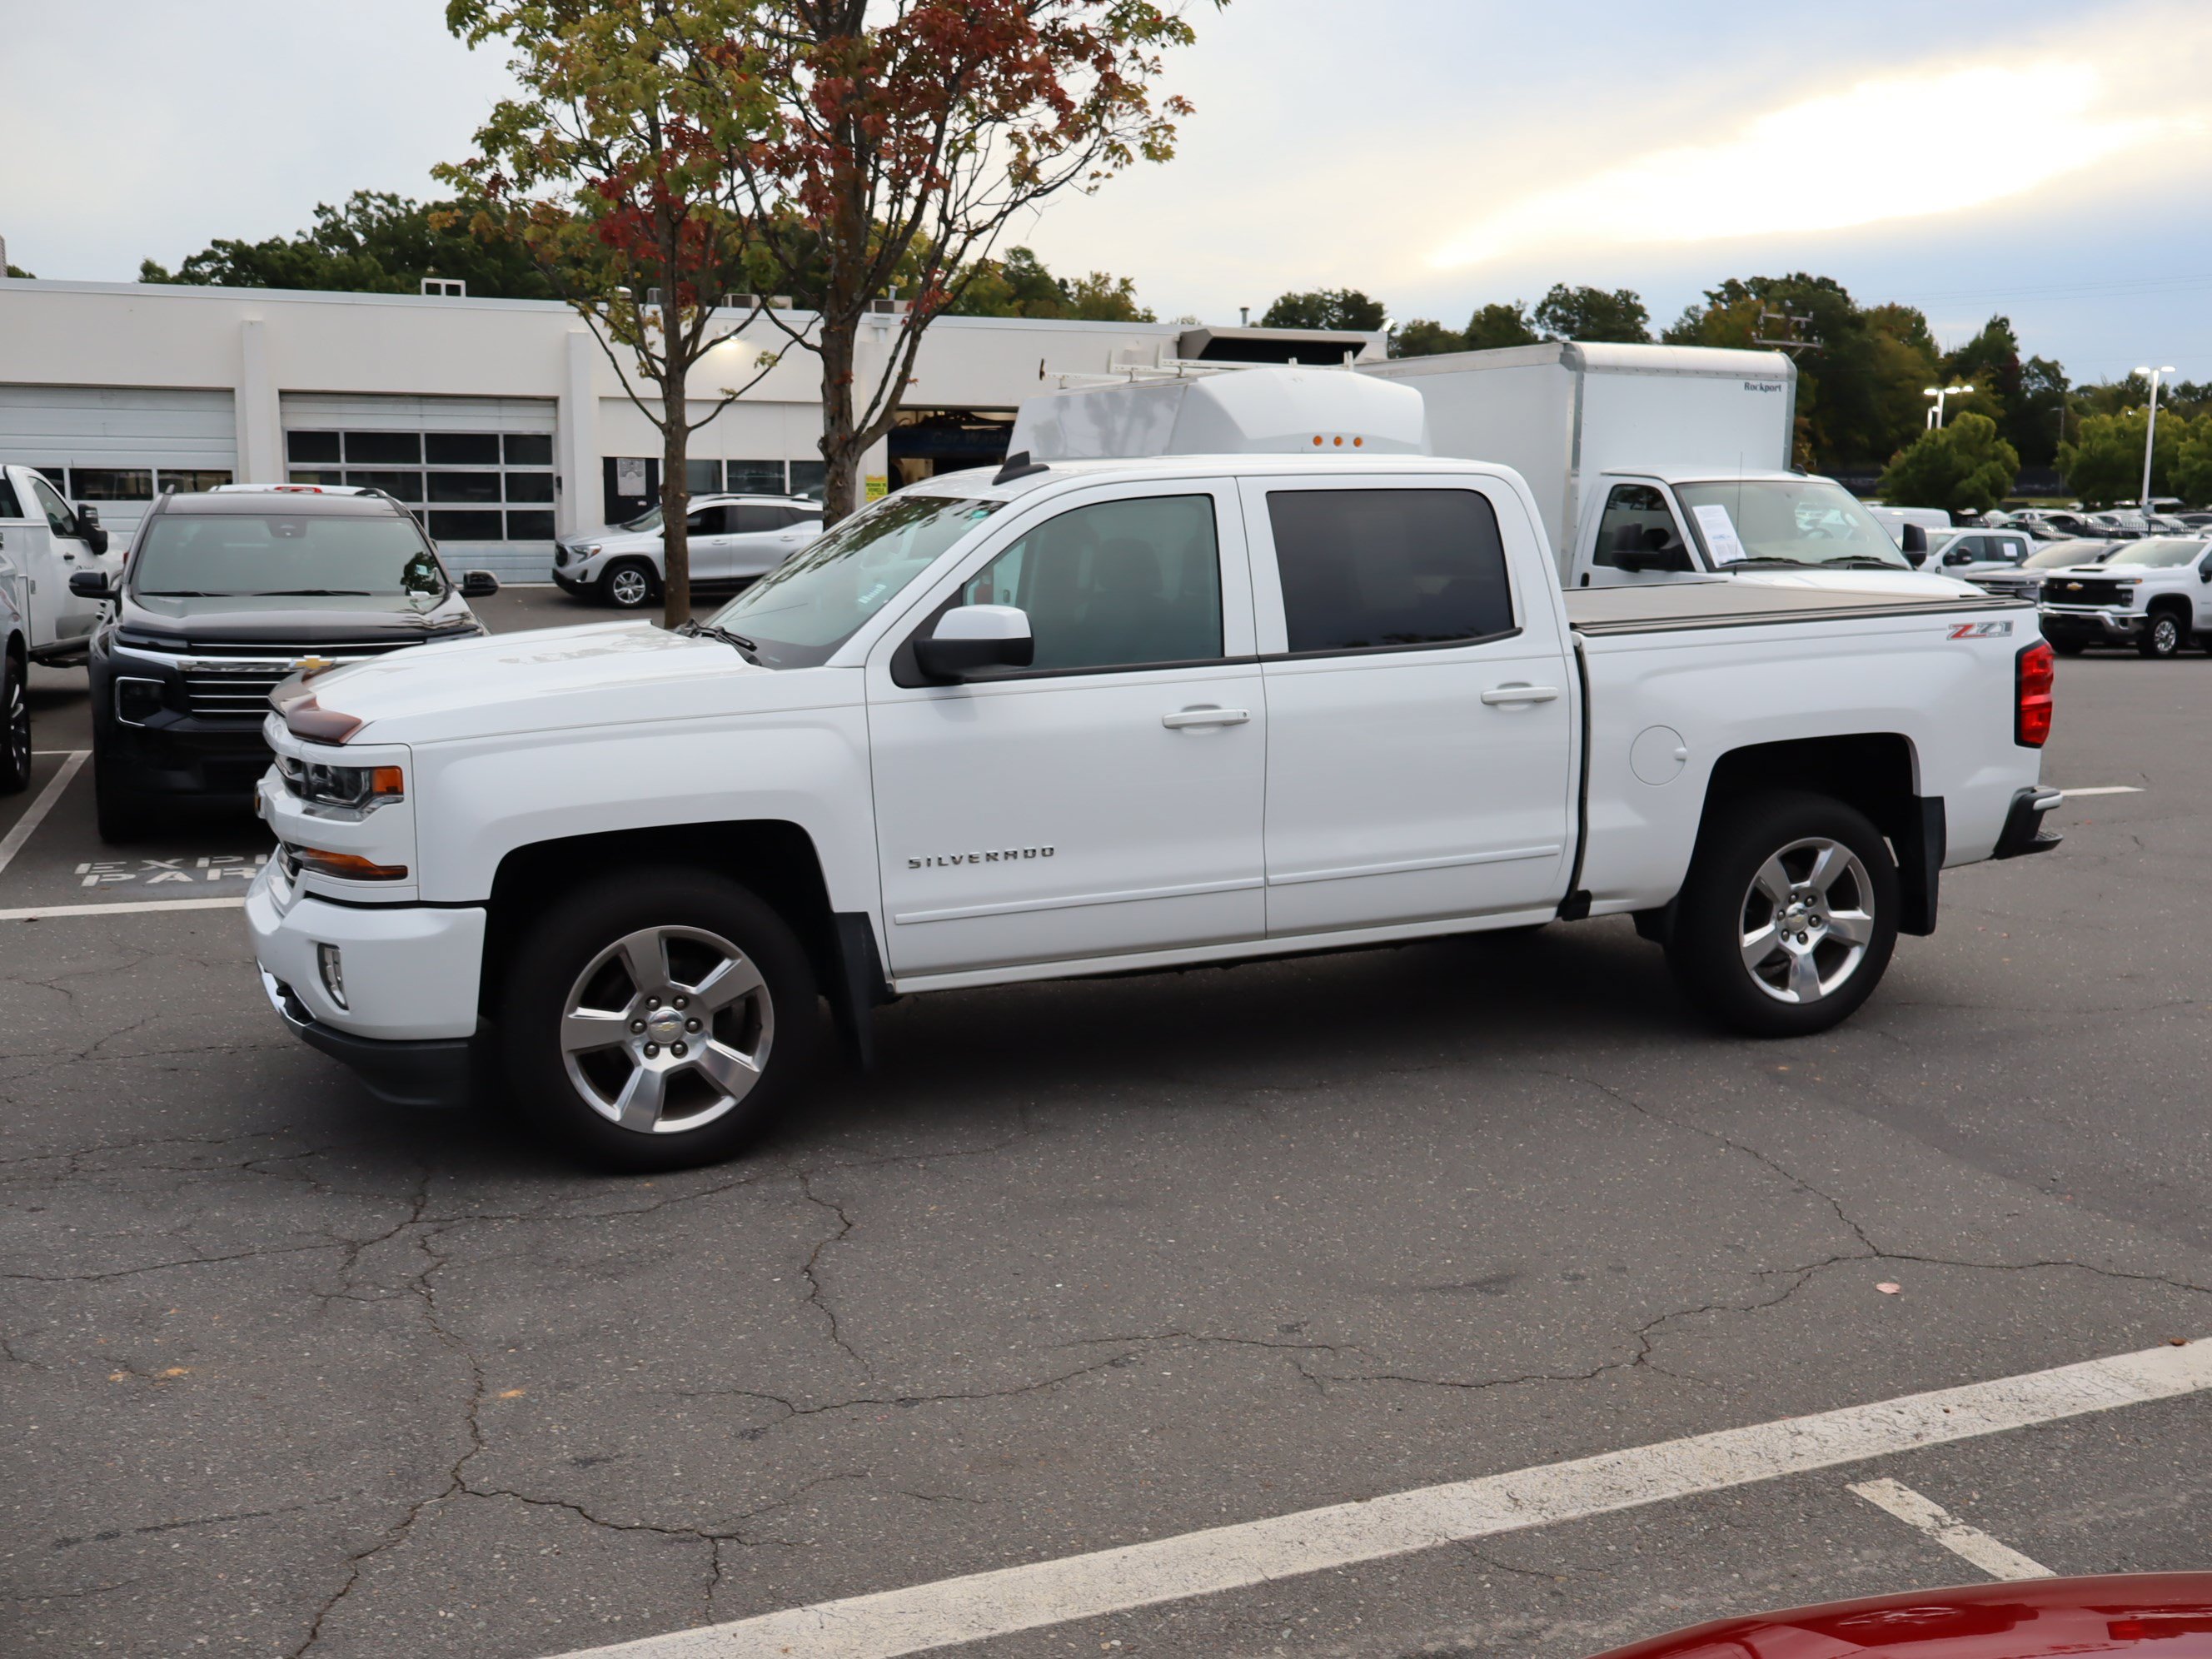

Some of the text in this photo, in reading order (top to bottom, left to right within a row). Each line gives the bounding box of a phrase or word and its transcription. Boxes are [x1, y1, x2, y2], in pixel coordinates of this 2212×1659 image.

[1744, 381, 1781, 393] Rockport
[933, 431, 959, 444] Car
[1946, 620, 2014, 640] Z71
[909, 845, 1055, 869] SILVERADO
